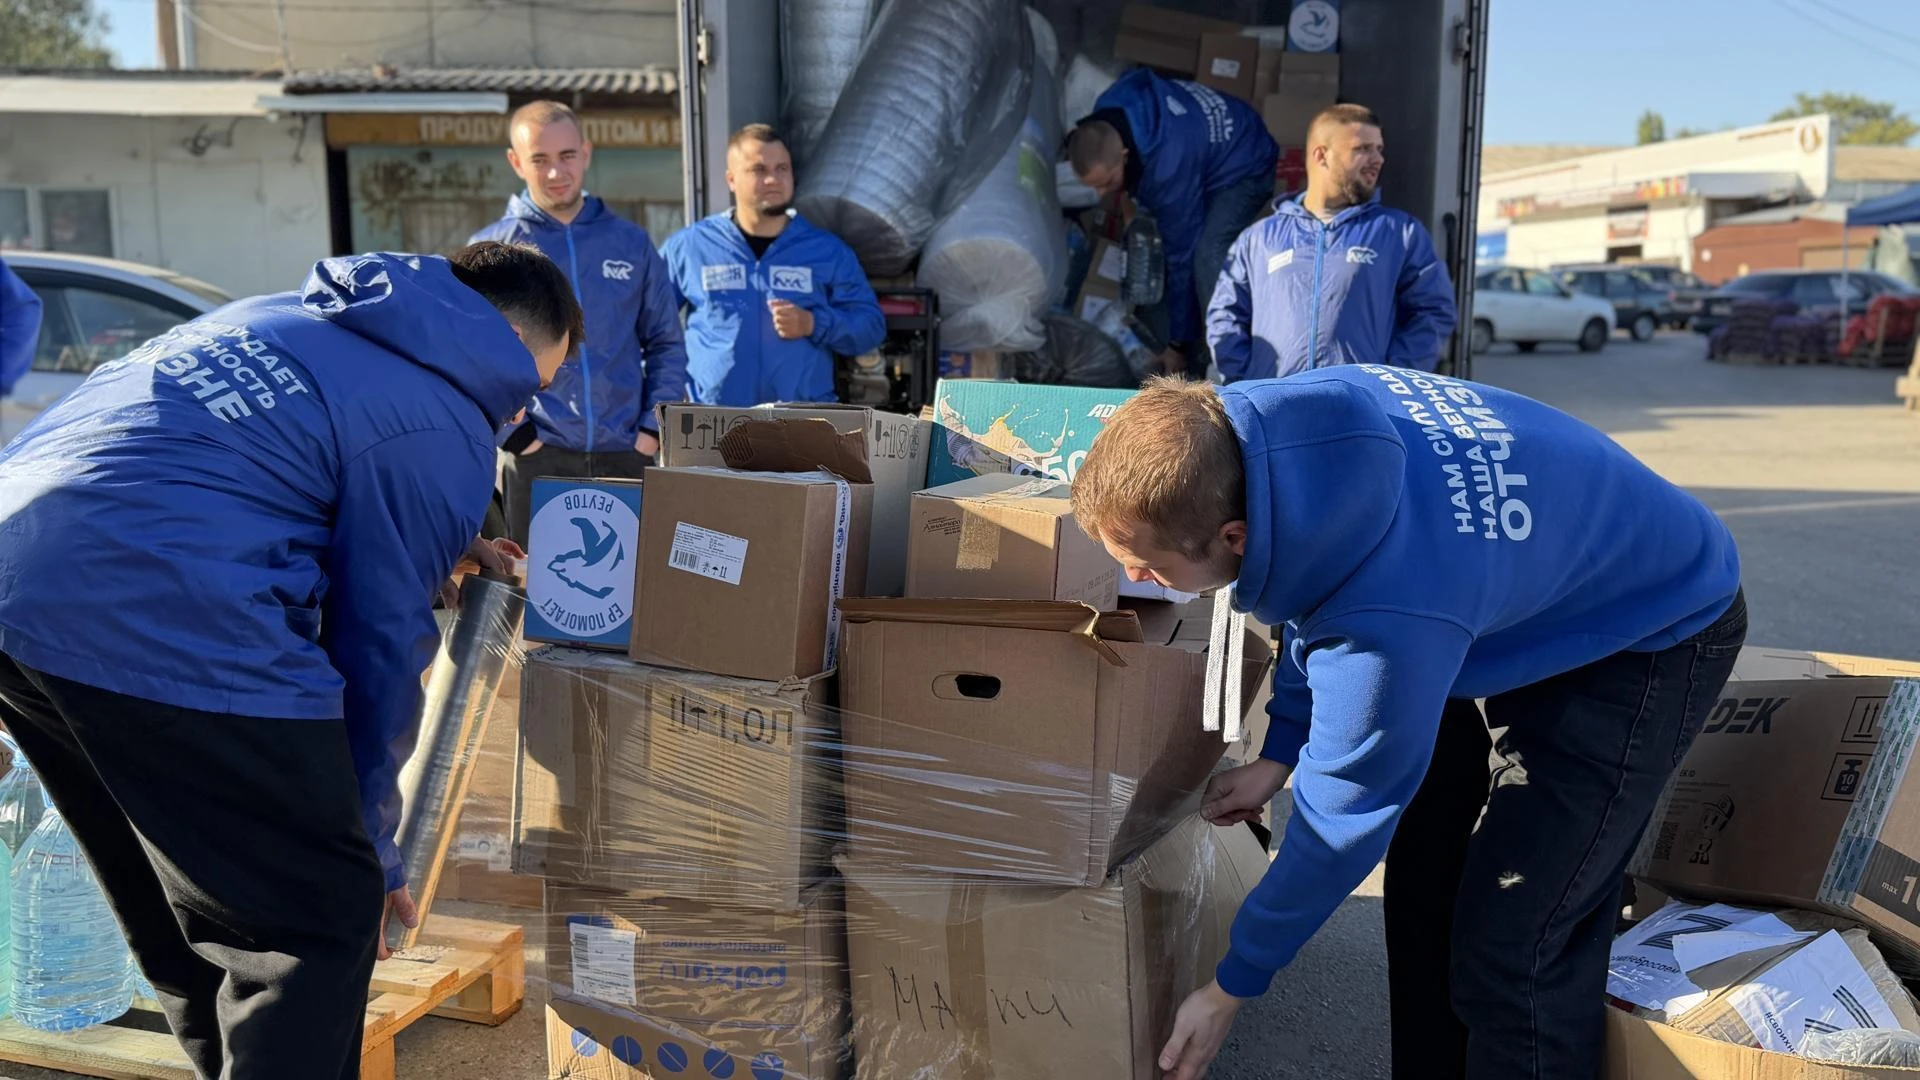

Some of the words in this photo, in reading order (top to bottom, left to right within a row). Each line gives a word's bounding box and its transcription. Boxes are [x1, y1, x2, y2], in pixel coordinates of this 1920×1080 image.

[420, 116, 509, 142] ПРОДУ
[581, 118, 646, 143] ПТОМ
[155, 352, 253, 424] ЗНЕ
[190, 334, 277, 410] РНОСТЬ
[236, 338, 309, 396] ДАЕТ
[1086, 404, 1121, 418] AD
[1388, 366, 1477, 440] ВЕРНОС
[1401, 400, 1454, 457] СИЛУ
[1422, 371, 1532, 542] ОТЧИЗН
[564, 493, 615, 514] РЕУТОВ
[1441, 463, 1475, 533] НАМ
[1465, 444, 1499, 540] НАША
[540, 598, 606, 632] ПОМОГАЕТ
[608, 602, 625, 624] ЕР
[1842, 773, 1856, 786] 10
[1881, 881, 1899, 895] max
[1902, 875, 1920, 913] 1
[1764, 1011, 1798, 1055] #своихн
